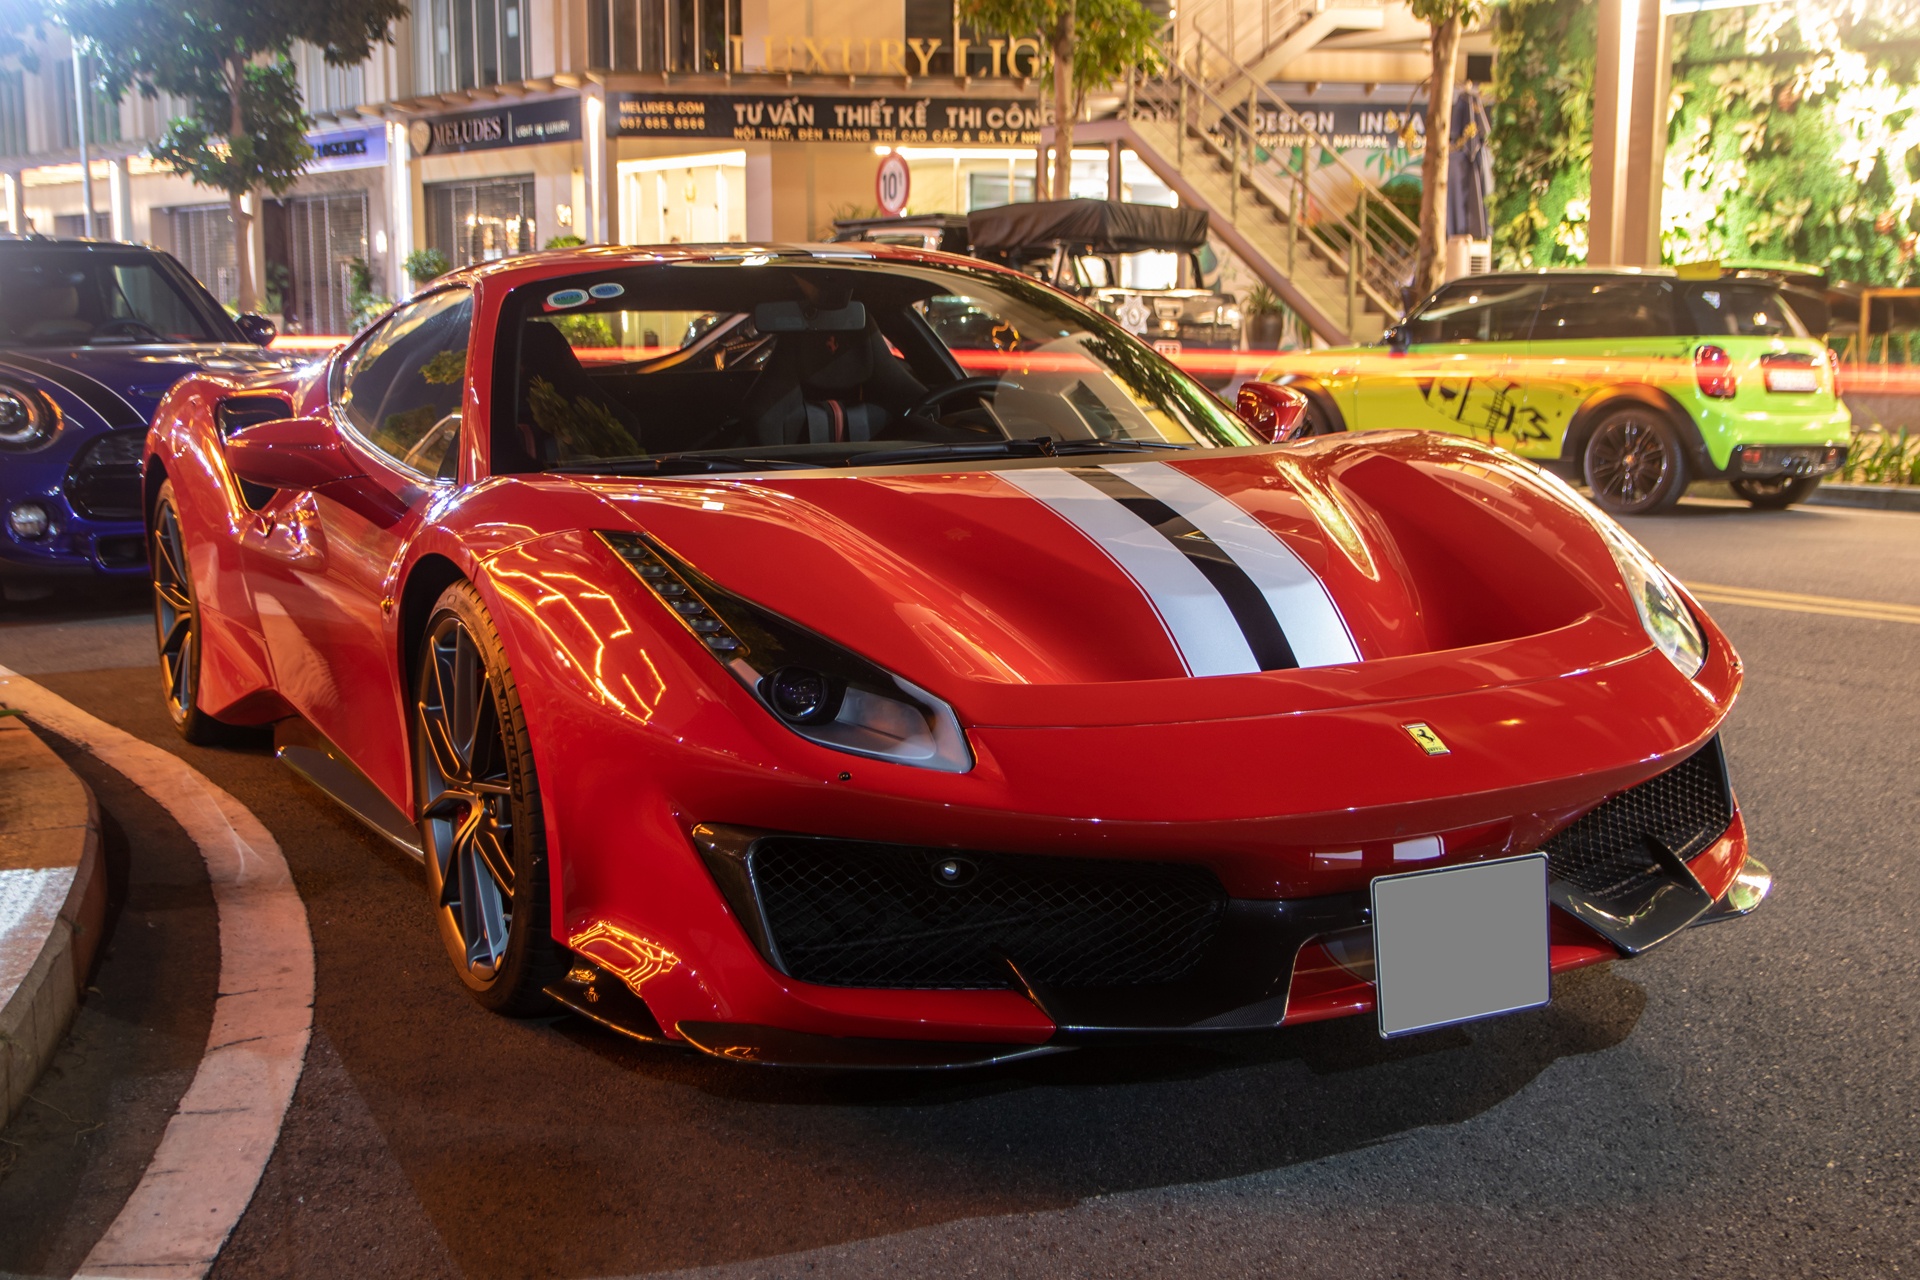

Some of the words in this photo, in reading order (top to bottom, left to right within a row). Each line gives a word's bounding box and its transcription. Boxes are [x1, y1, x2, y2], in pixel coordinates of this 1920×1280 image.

[730, 34, 942, 77] LUXURY
[618, 100, 705, 115] MELUDES.COM
[733, 101, 764, 125] TƯ
[767, 96, 815, 126] VẤN
[834, 97, 894, 127] THIẾT
[898, 96, 931, 128] KẾ
[945, 106, 982, 128] THI
[432, 116, 503, 146] MELUDES
[733, 126, 756, 141] NỘI
[828, 128, 871, 142] TRANG
[876, 126, 897, 142] TRÍ
[901, 130, 927, 143] CAO
[1254, 110, 1335, 133] DESIGN
[1333, 134, 1390, 149] NATURAL
[500, 697, 524, 801] MICHELIN
